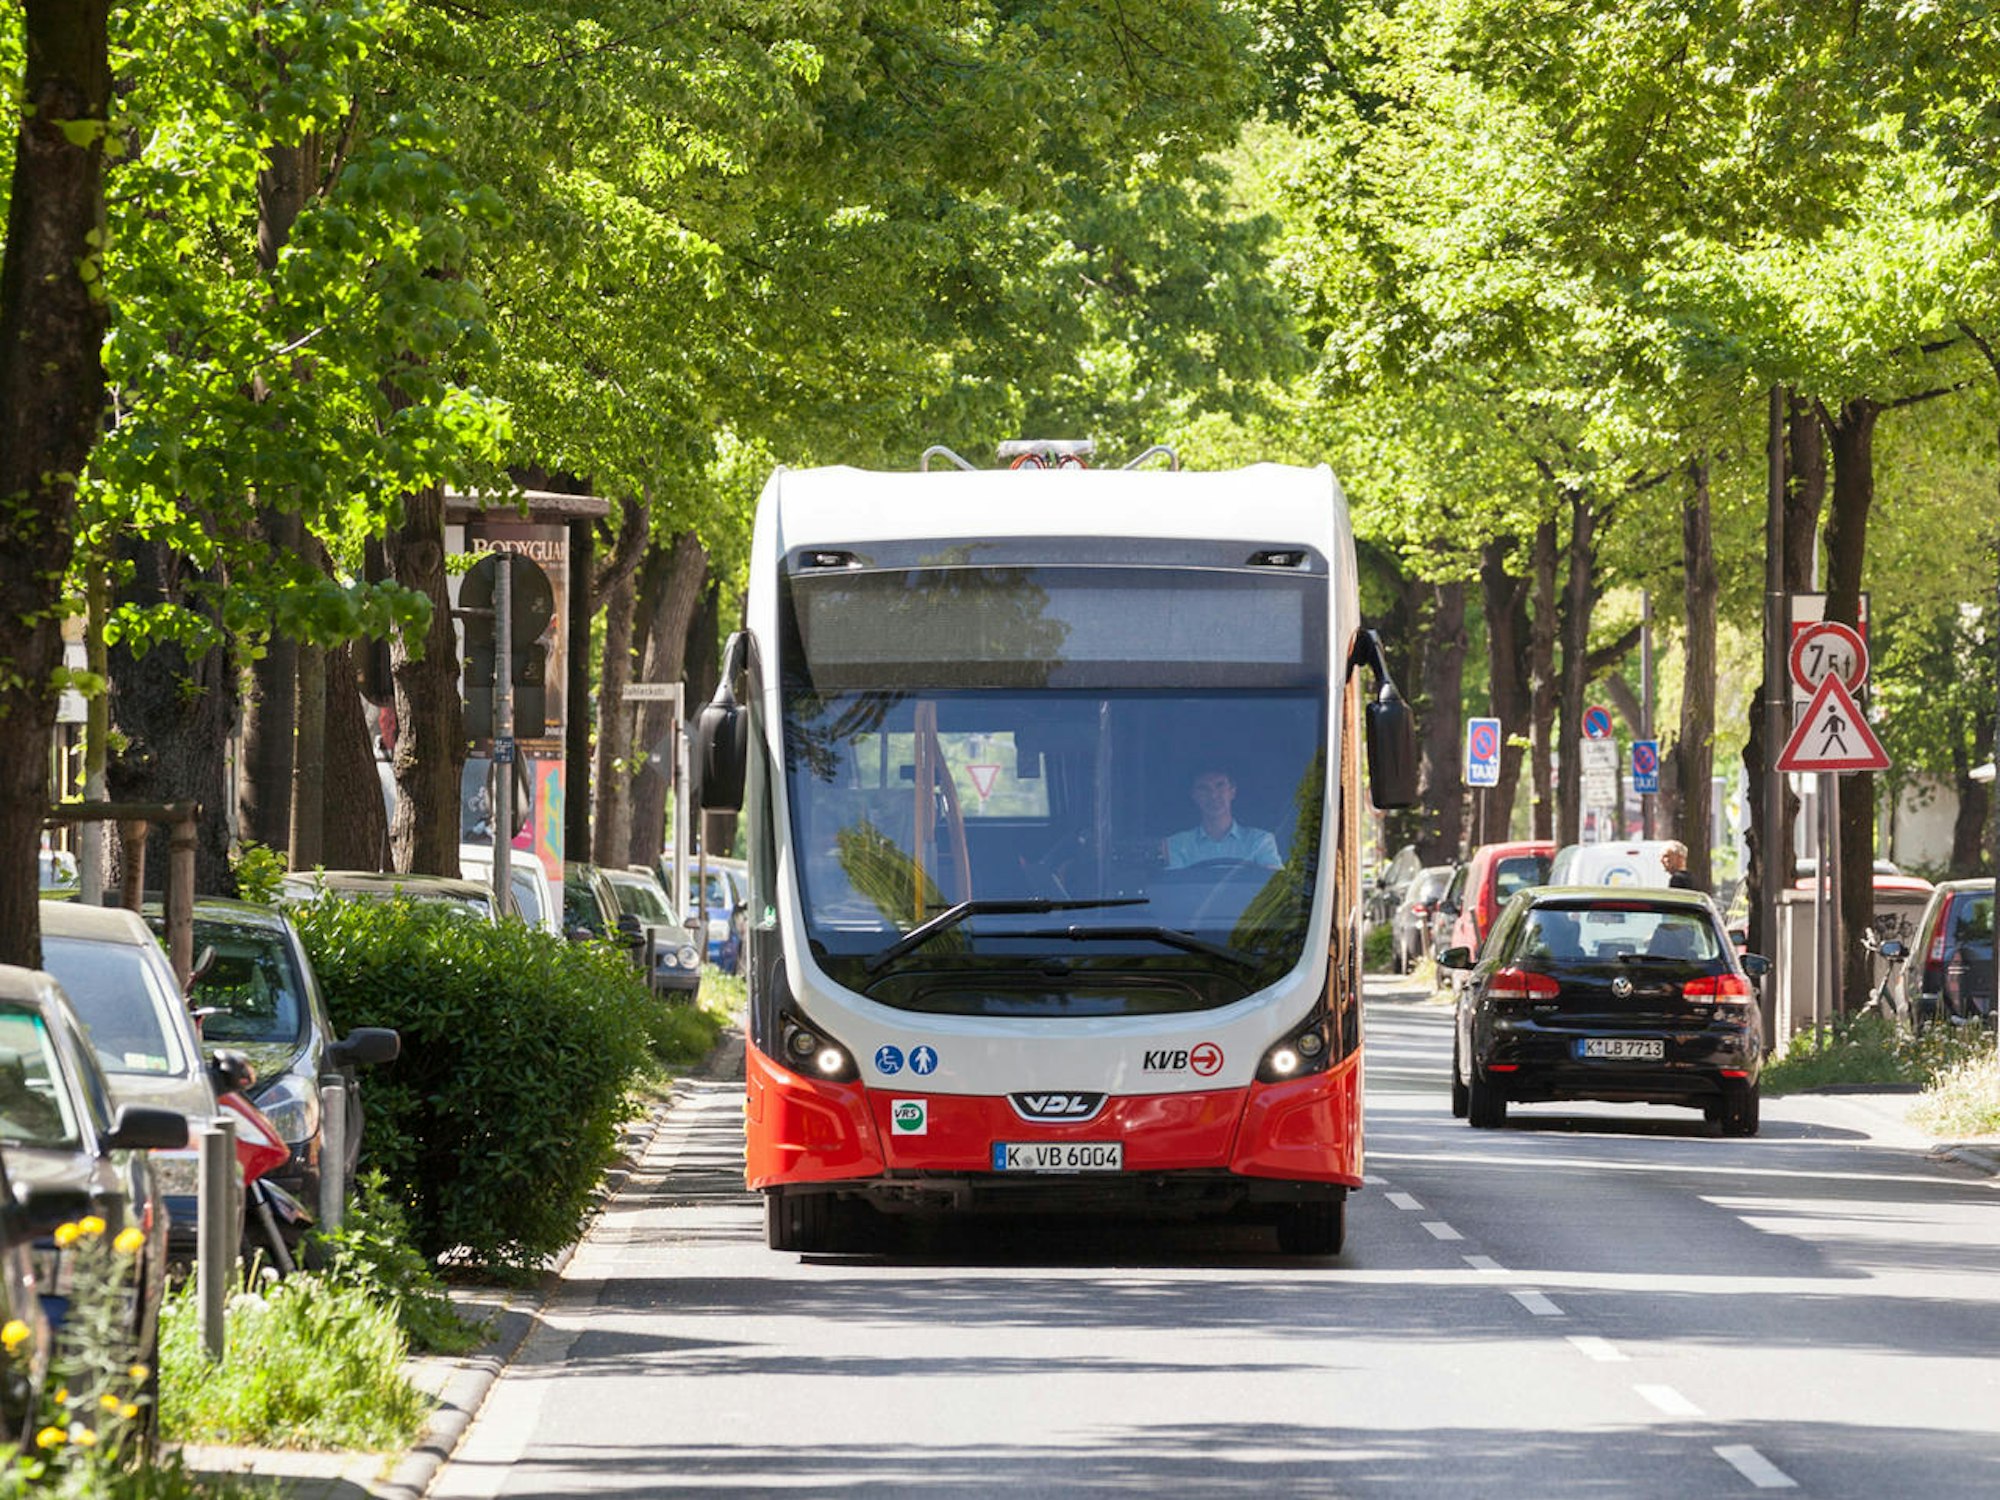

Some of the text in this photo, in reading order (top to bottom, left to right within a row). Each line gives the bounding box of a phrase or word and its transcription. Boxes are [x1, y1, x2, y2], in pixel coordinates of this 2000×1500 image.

[472, 538, 564, 561] BODYGUA
[1471, 764, 1499, 779] TAXI
[1587, 1041, 1662, 1056] K LB 7713
[1143, 1050, 1188, 1070] KVB
[1023, 1095, 1089, 1113] VDL
[894, 1109, 916, 1118] VRS
[1007, 1146, 1118, 1166] K VB 6004
